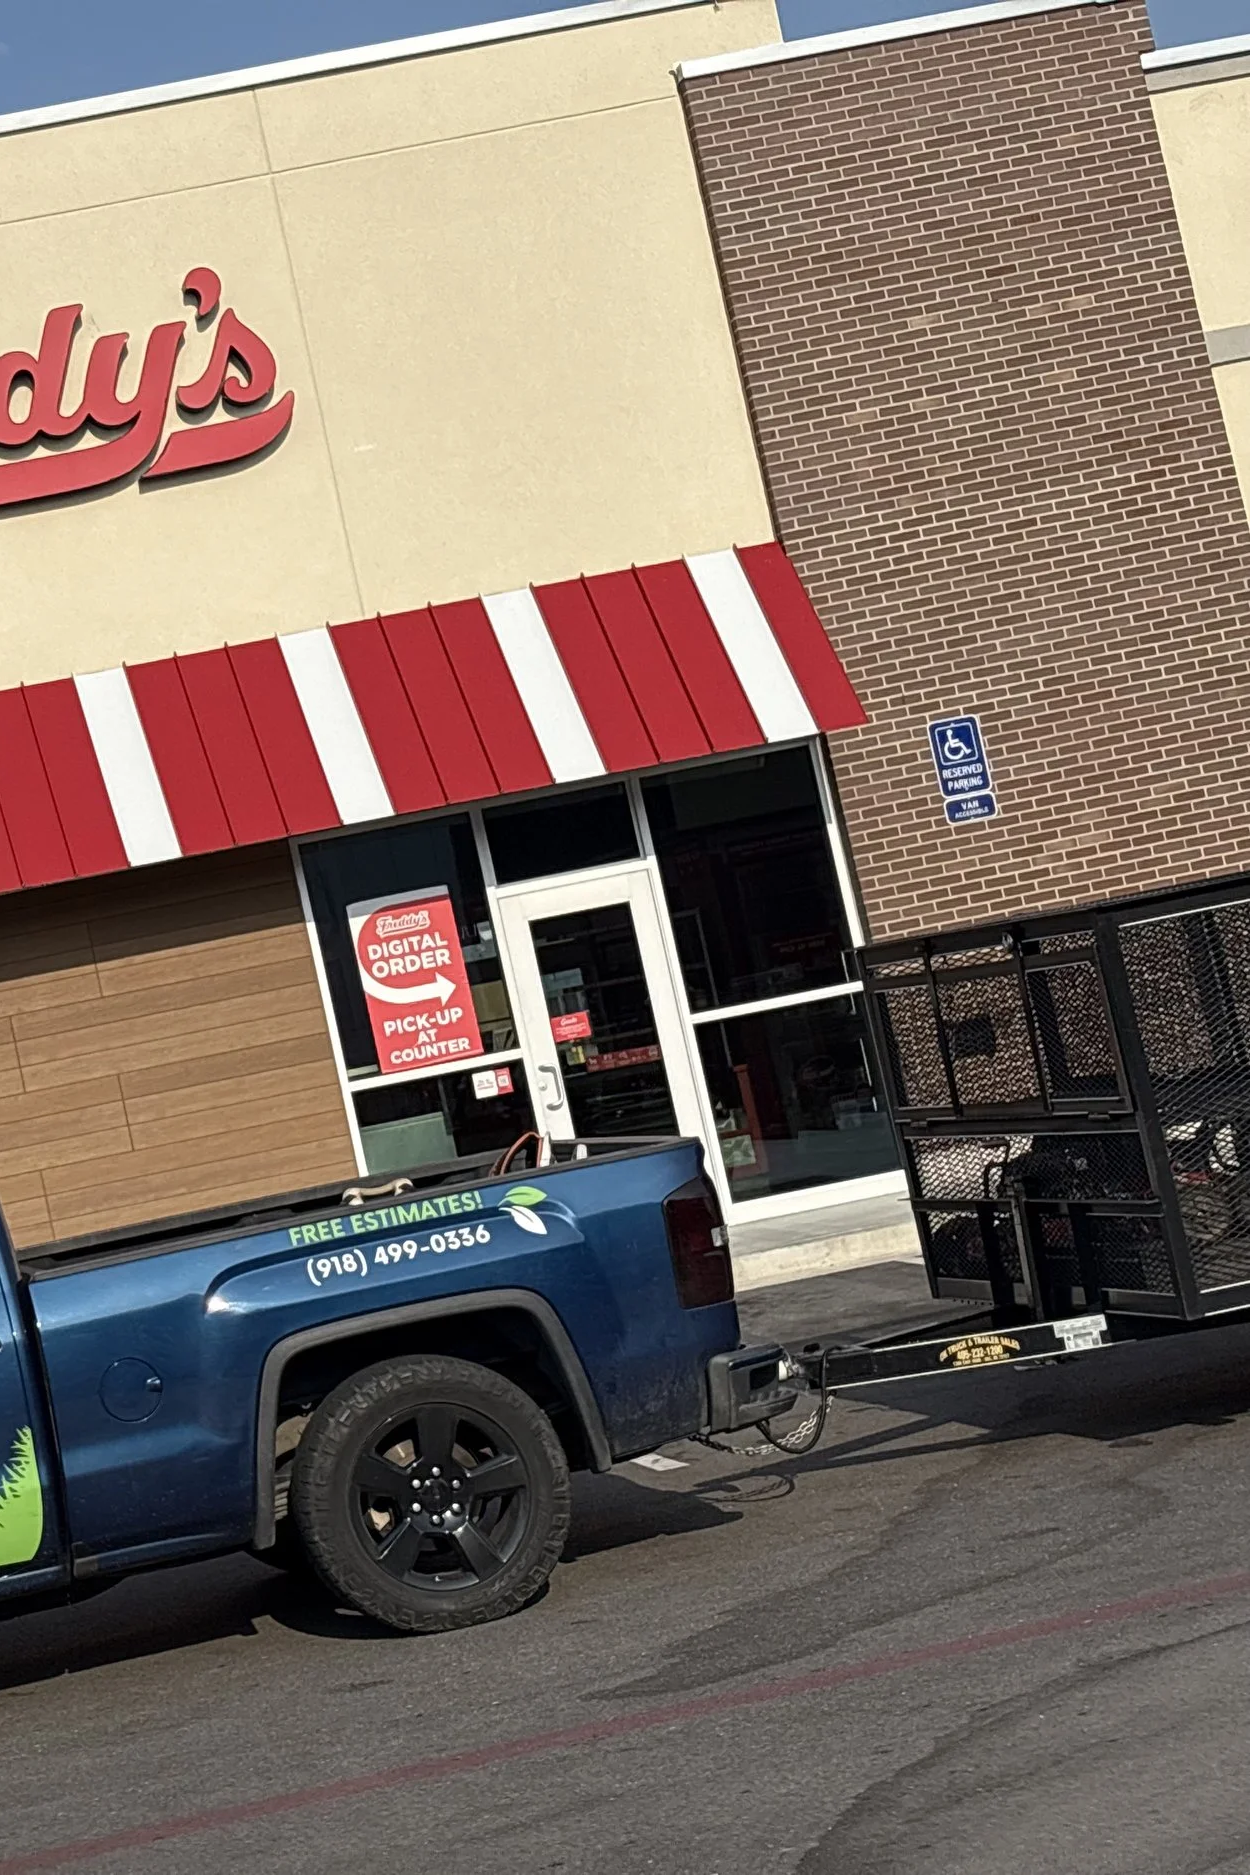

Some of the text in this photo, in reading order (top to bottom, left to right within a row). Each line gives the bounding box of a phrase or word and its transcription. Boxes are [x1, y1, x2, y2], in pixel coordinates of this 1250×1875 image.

[942, 763, 983, 779] RESERVED
[947, 776, 983, 791] PARKING
[961, 800, 979, 811] VAN
[376, 910, 430, 938] Freddy's
[367, 932, 448, 960] DIGITAL
[371, 949, 452, 979] ORDER
[383, 1007, 463, 1037] PICK-UP
[417, 1028, 438, 1044] AT
[390, 1037, 470, 1064] COUNTER
[288, 1190, 483, 1246] FREE ESTIMATES!
[307, 1224, 491, 1286] (918) 499-0336
[947, 1340, 967, 1355] TRUCK
[973, 1336, 999, 1345] TRAILER
[1000, 1336, 1021, 1350] SALES
